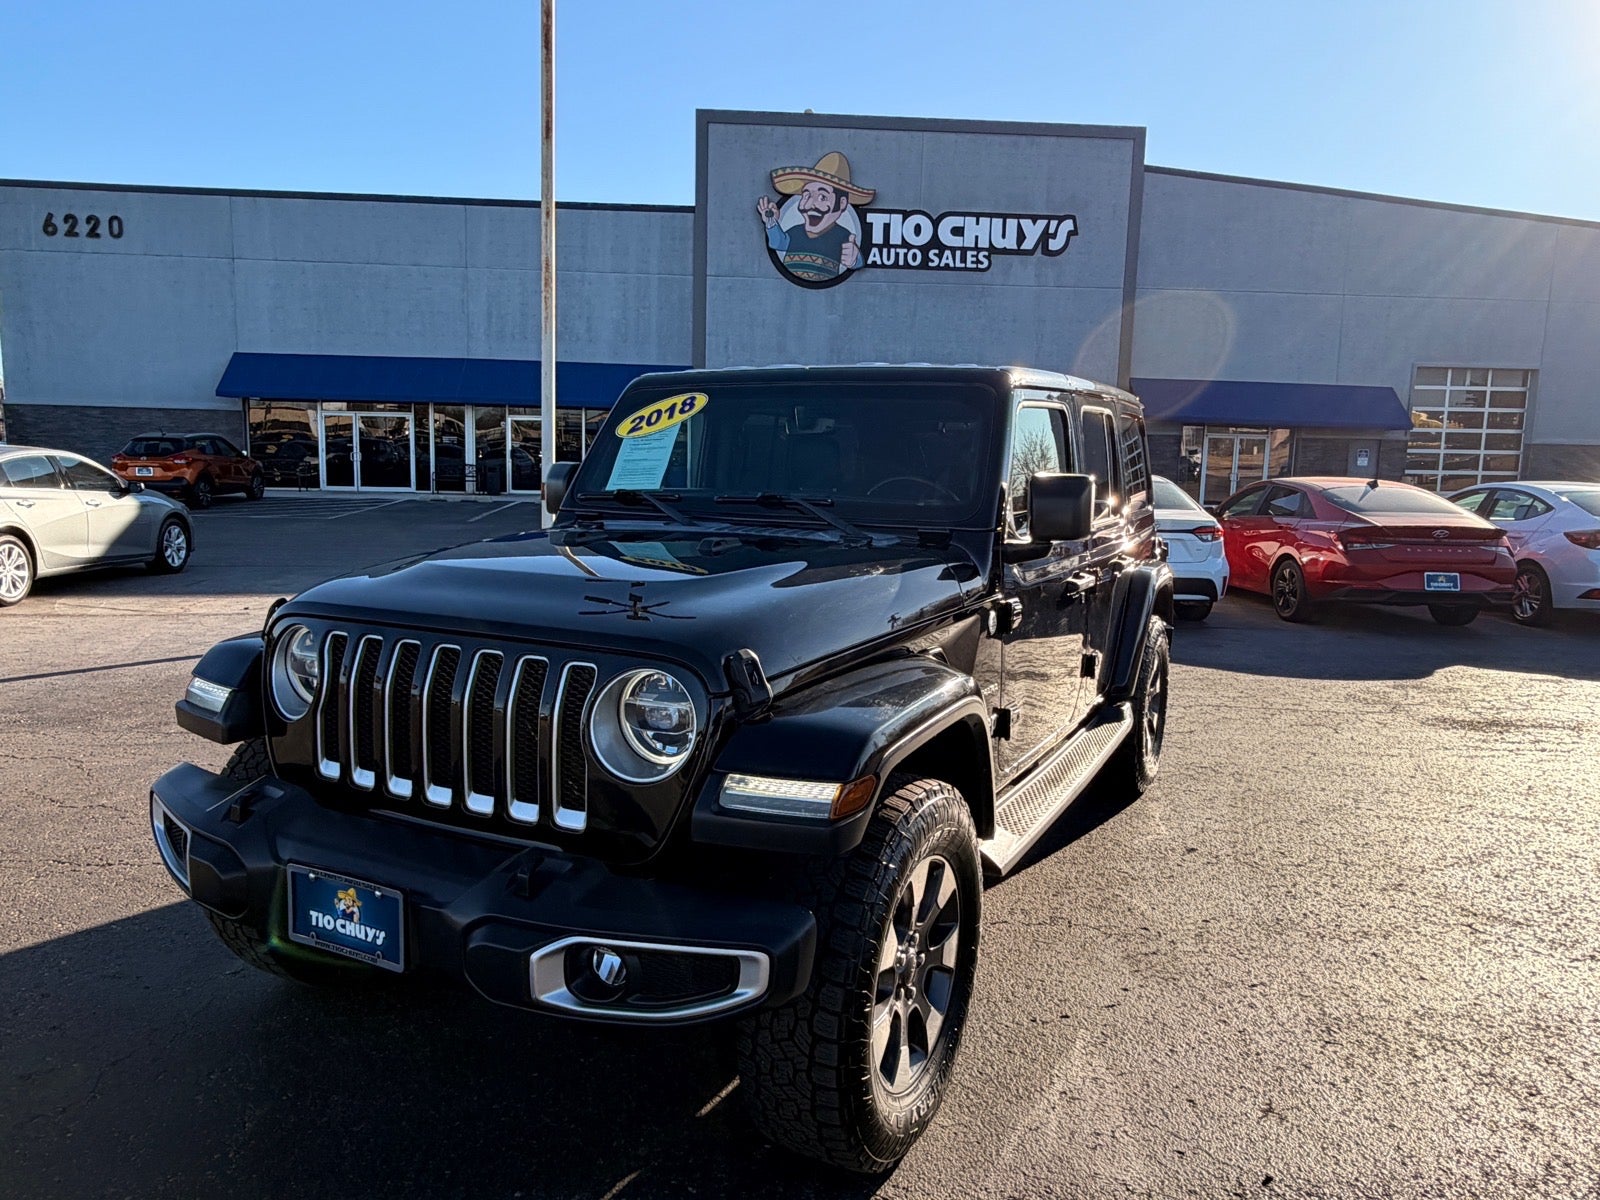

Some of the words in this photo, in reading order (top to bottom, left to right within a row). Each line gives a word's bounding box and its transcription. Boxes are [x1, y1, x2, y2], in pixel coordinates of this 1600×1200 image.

[42, 212, 124, 239] 6220
[866, 213, 934, 246] TIO
[937, 215, 1074, 250] CHUY'S
[867, 247, 922, 267] AUTO
[927, 249, 989, 269] SALES
[626, 395, 697, 435] 2018
[309, 910, 334, 930] TIO
[336, 918, 386, 945] CHUY'S
